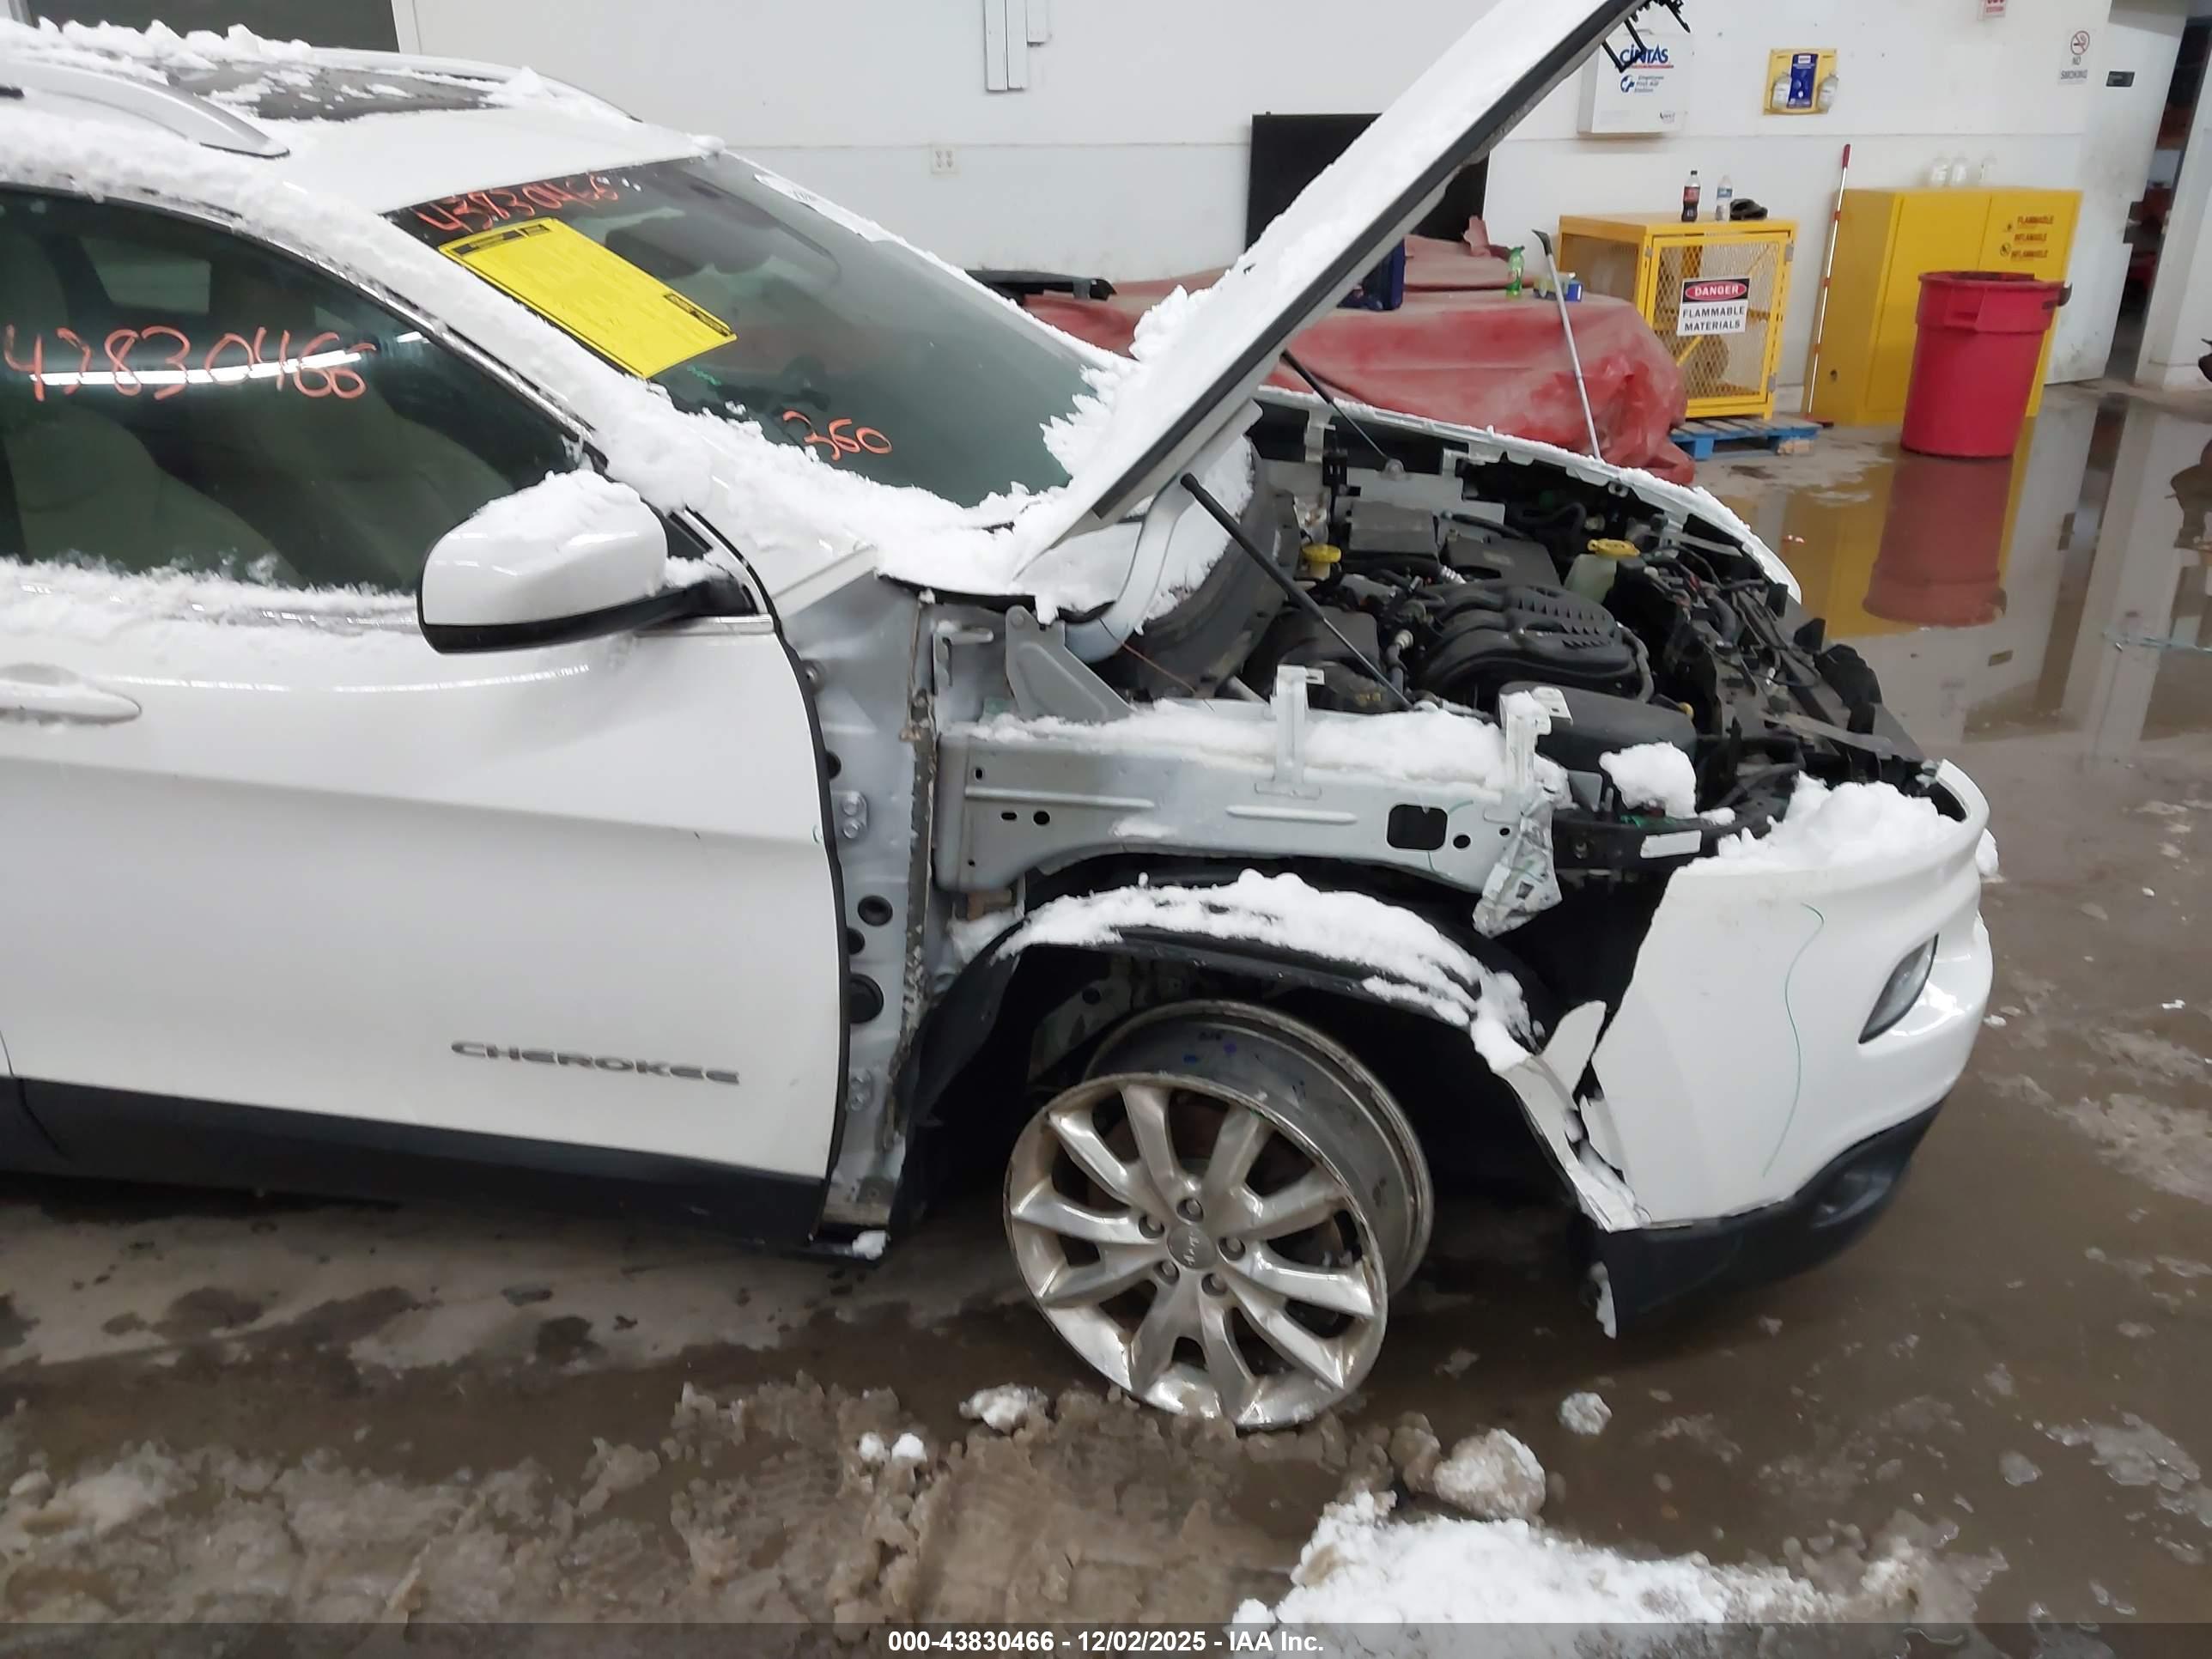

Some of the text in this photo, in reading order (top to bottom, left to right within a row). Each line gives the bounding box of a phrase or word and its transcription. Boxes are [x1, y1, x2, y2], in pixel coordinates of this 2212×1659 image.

[1694, 284, 1739, 296] DANGER
[1683, 306, 1745, 318] FLAMMABLE
[1684, 320, 1740, 331] MATERIALS
[451, 1040, 740, 1085] CHEROKEE
